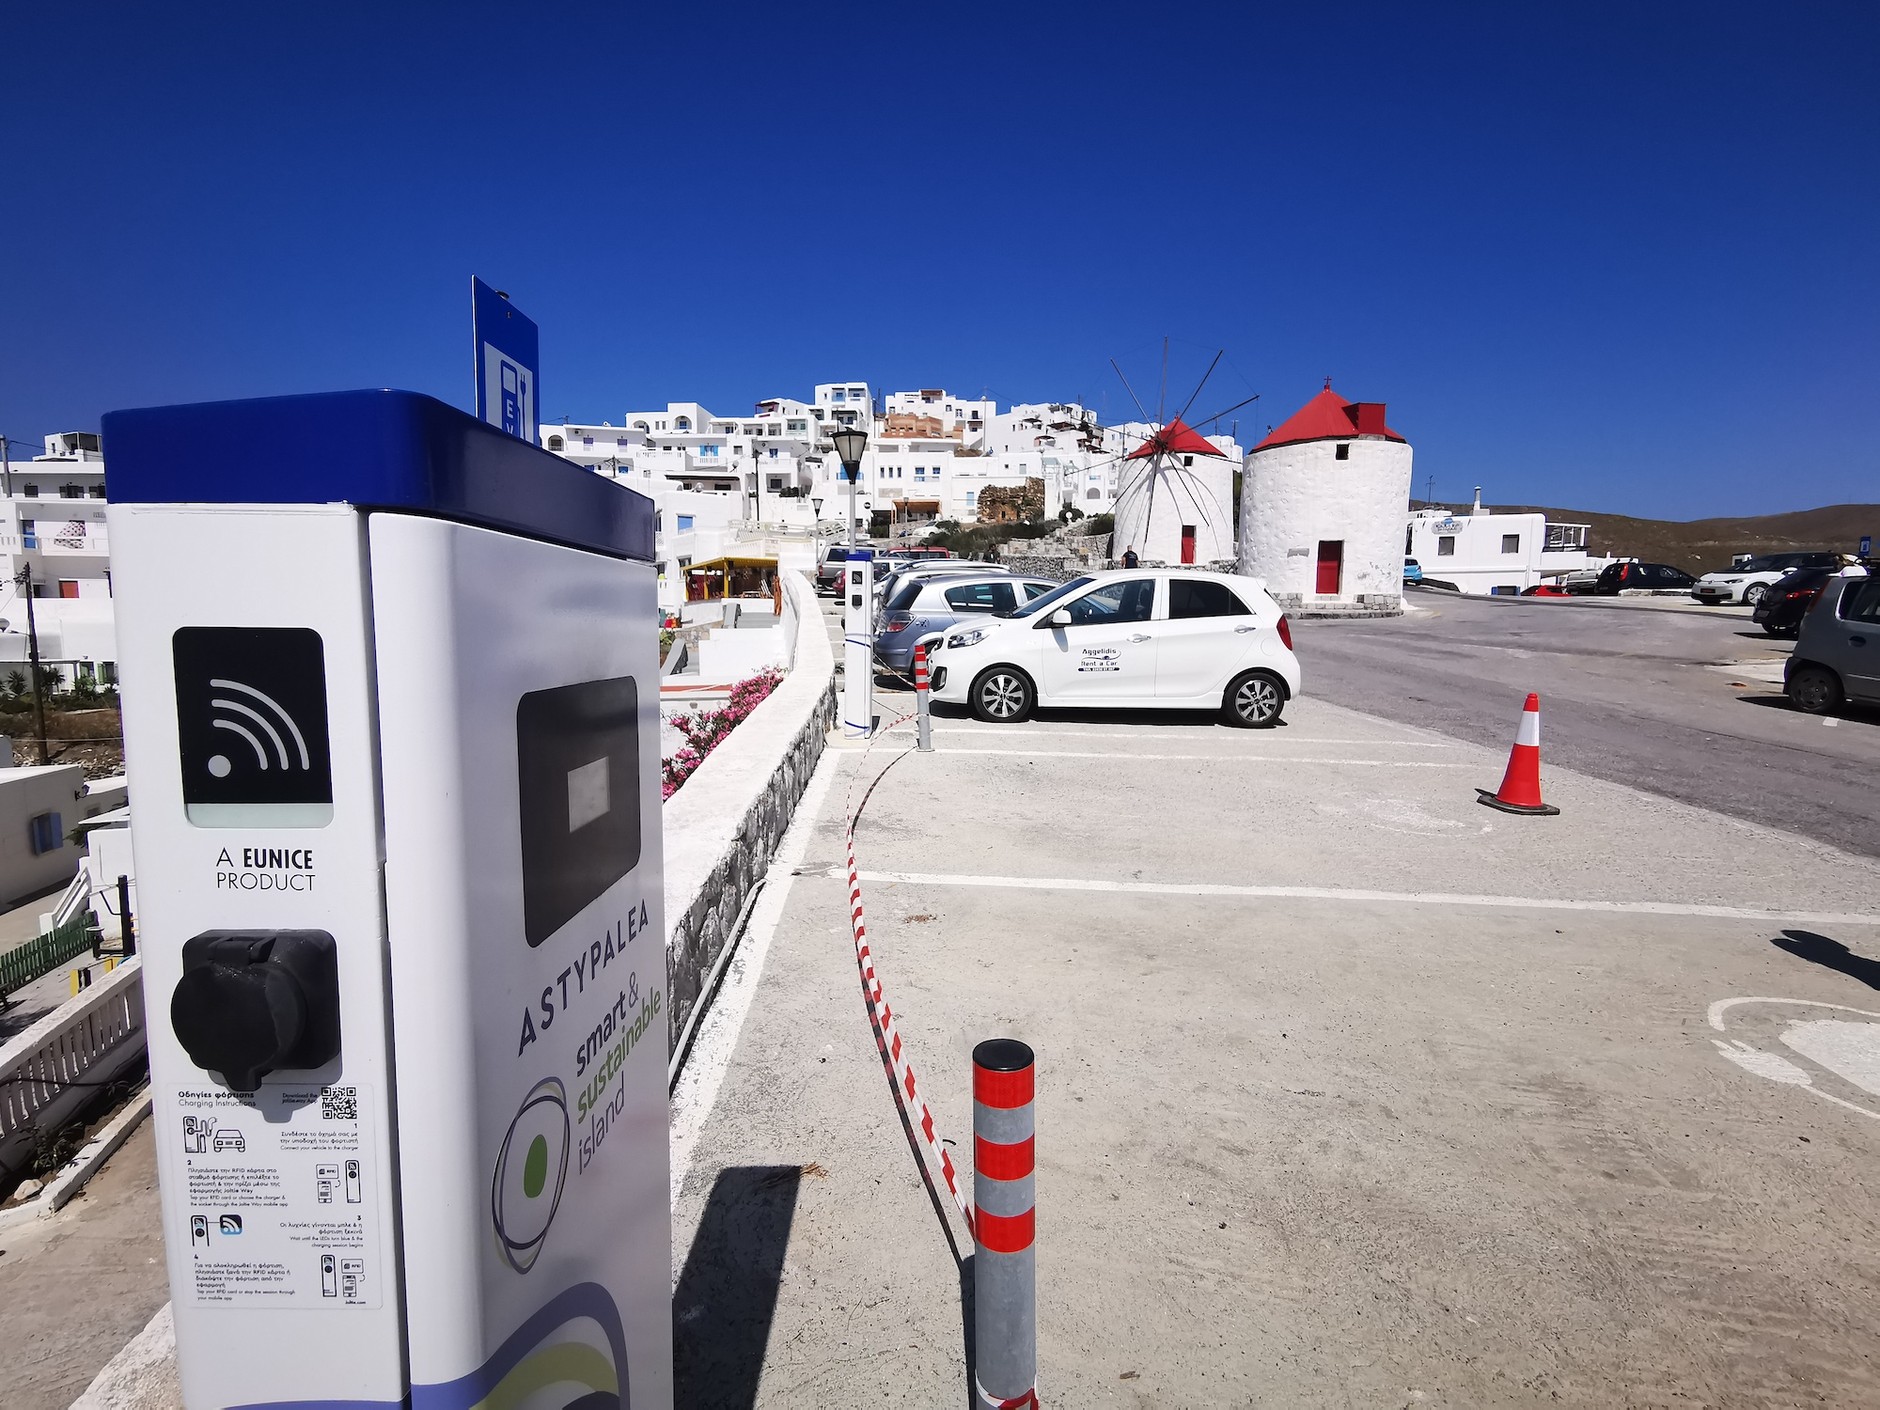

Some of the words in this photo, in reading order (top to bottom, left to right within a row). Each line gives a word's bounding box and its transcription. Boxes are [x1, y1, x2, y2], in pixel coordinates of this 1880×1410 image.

[1082, 648, 1117, 656] Aggelidis
[216, 847, 234, 867] A
[243, 848, 313, 869] EUNICE
[217, 872, 316, 891] PRODUCT
[518, 898, 649, 1058] ASTYPALEA
[576, 989, 627, 1078] smart
[628, 970, 639, 1008] &
[577, 986, 662, 1126] sustainable
[178, 1099, 213, 1108] Charging
[215, 1099, 257, 1107] Instructions
[578, 1070, 626, 1176] island
